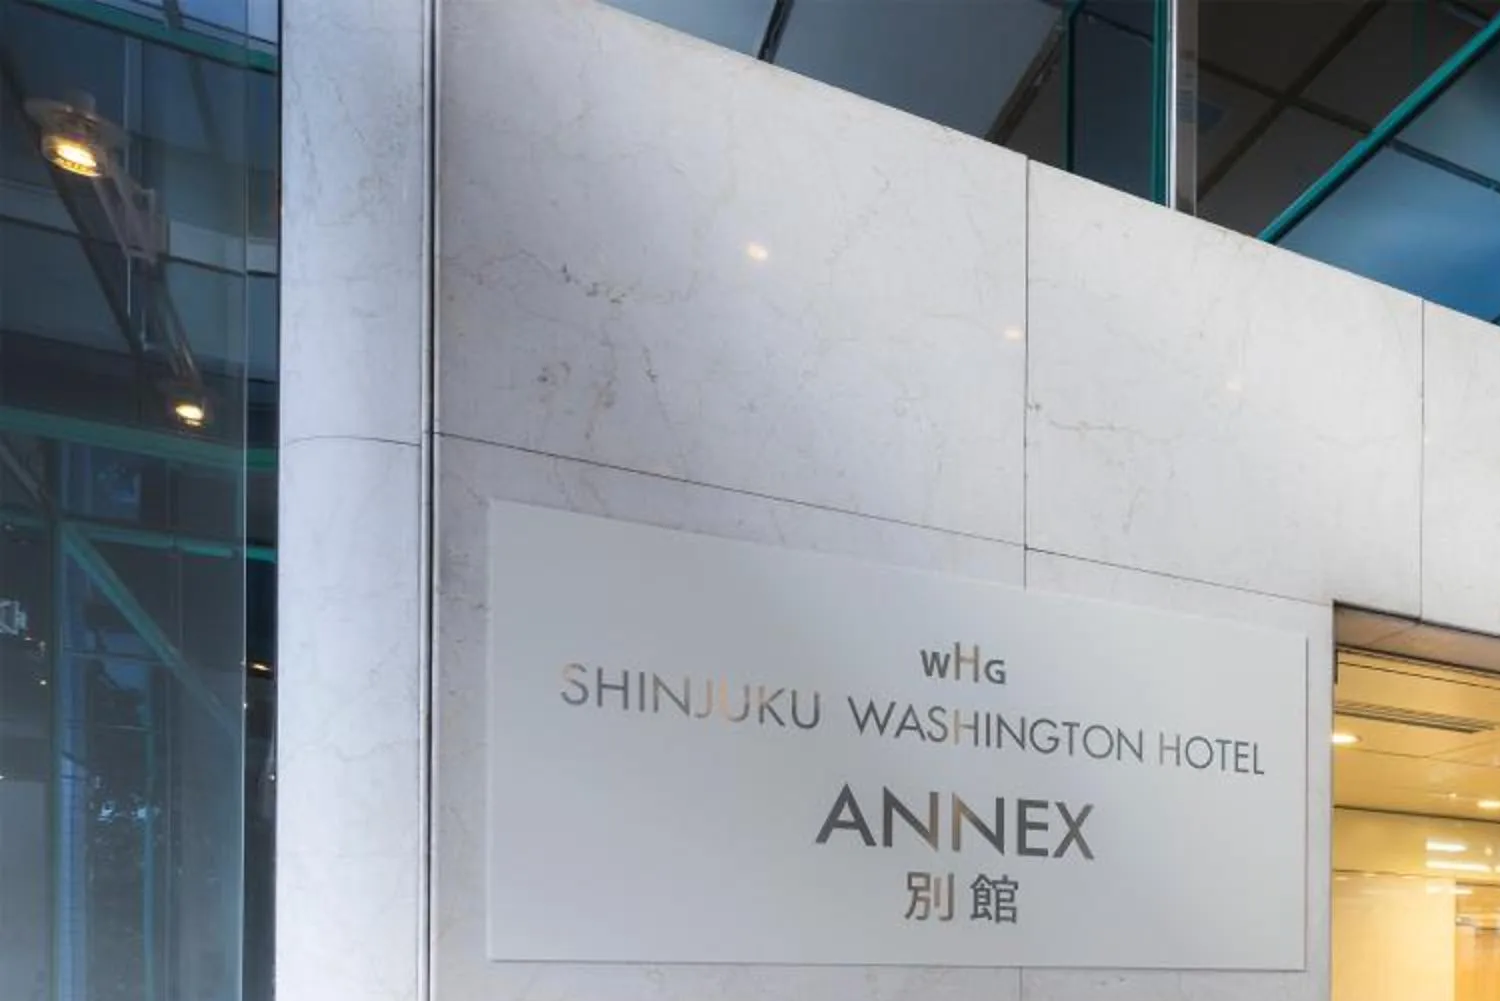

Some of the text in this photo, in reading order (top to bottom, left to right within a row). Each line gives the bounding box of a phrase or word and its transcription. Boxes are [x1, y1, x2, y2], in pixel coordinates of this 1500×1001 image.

[560, 664, 1265, 775] SHINJUKU WASHINGTON HOTEL
[815, 783, 1095, 860] ANNEX
[905, 871, 1018, 924] 別館
